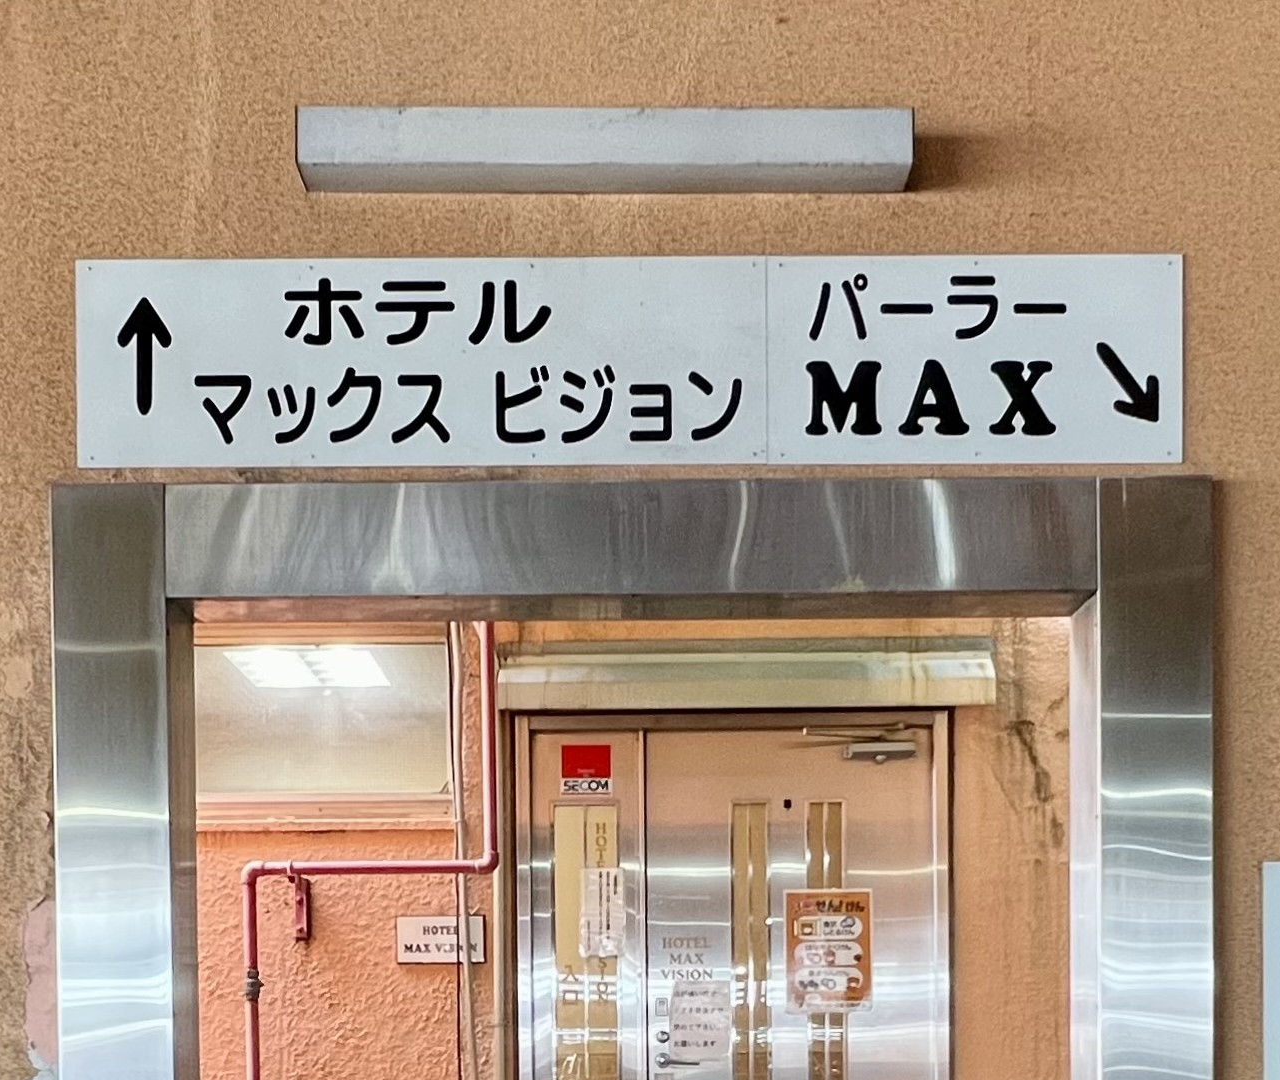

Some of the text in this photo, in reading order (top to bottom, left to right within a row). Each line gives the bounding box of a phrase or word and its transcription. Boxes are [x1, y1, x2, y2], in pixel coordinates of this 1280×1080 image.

[285, 278, 551, 345] ホテル
[810, 274, 1067, 340] パーラー
[195, 365, 743, 444] マックス ビジョン
[806, 360, 1056, 436] MAX
[563, 780, 609, 792] SECOM
[404, 944, 431, 952] MAX
[662, 936, 712, 949] HOTEL
[669, 953, 704, 964] MAX
[562, 965, 579, 1005] 入口
[661, 969, 713, 980] VISION
